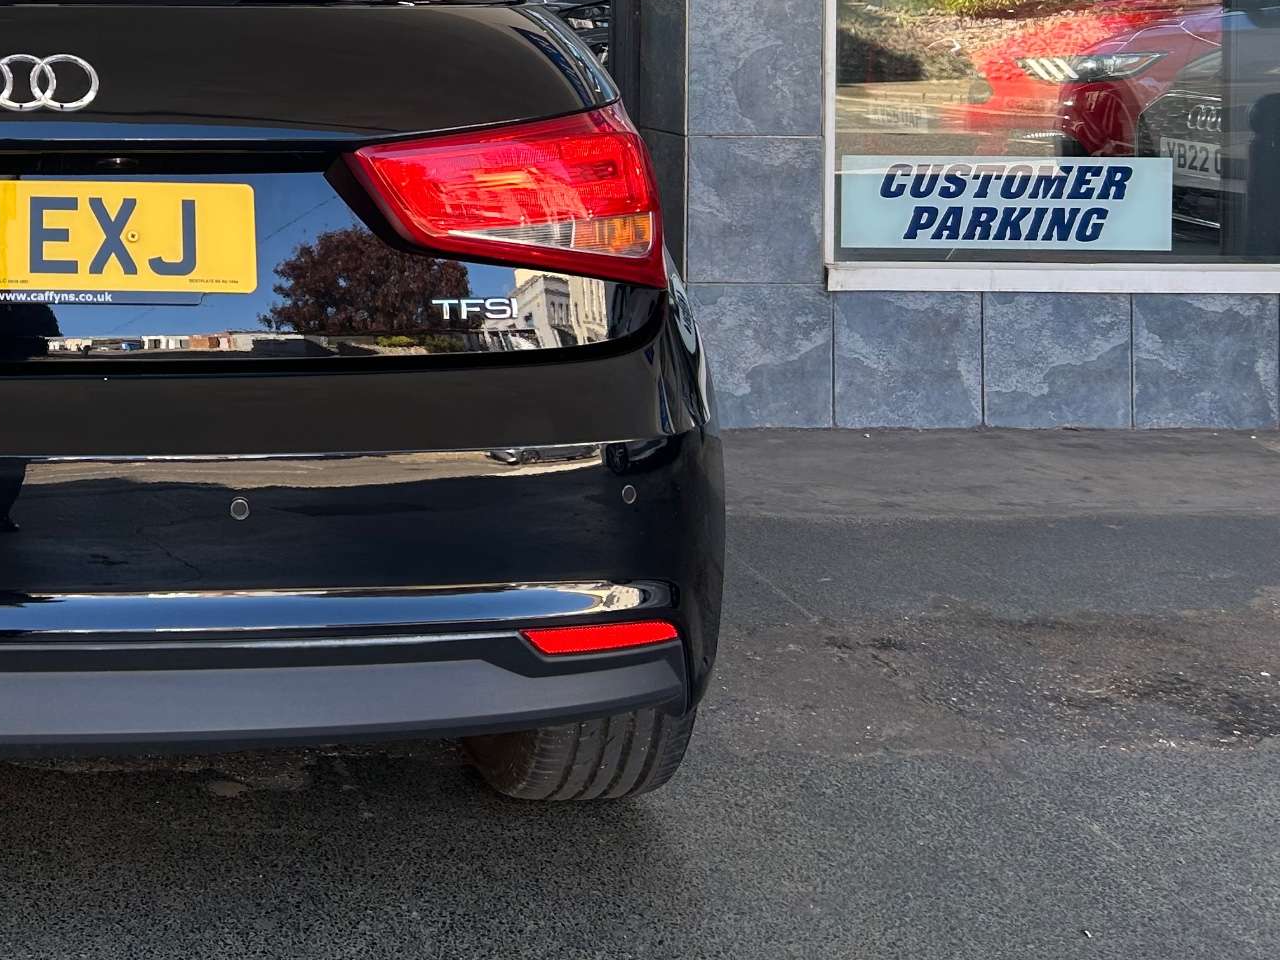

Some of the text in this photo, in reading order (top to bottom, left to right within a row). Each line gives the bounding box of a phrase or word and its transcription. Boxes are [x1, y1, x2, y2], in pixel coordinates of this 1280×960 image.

[880, 163, 1133, 200] CUSTOMER
[29, 196, 197, 276] EXJ
[903, 206, 1109, 242] PARKING
[431, 297, 518, 320] TFSI
